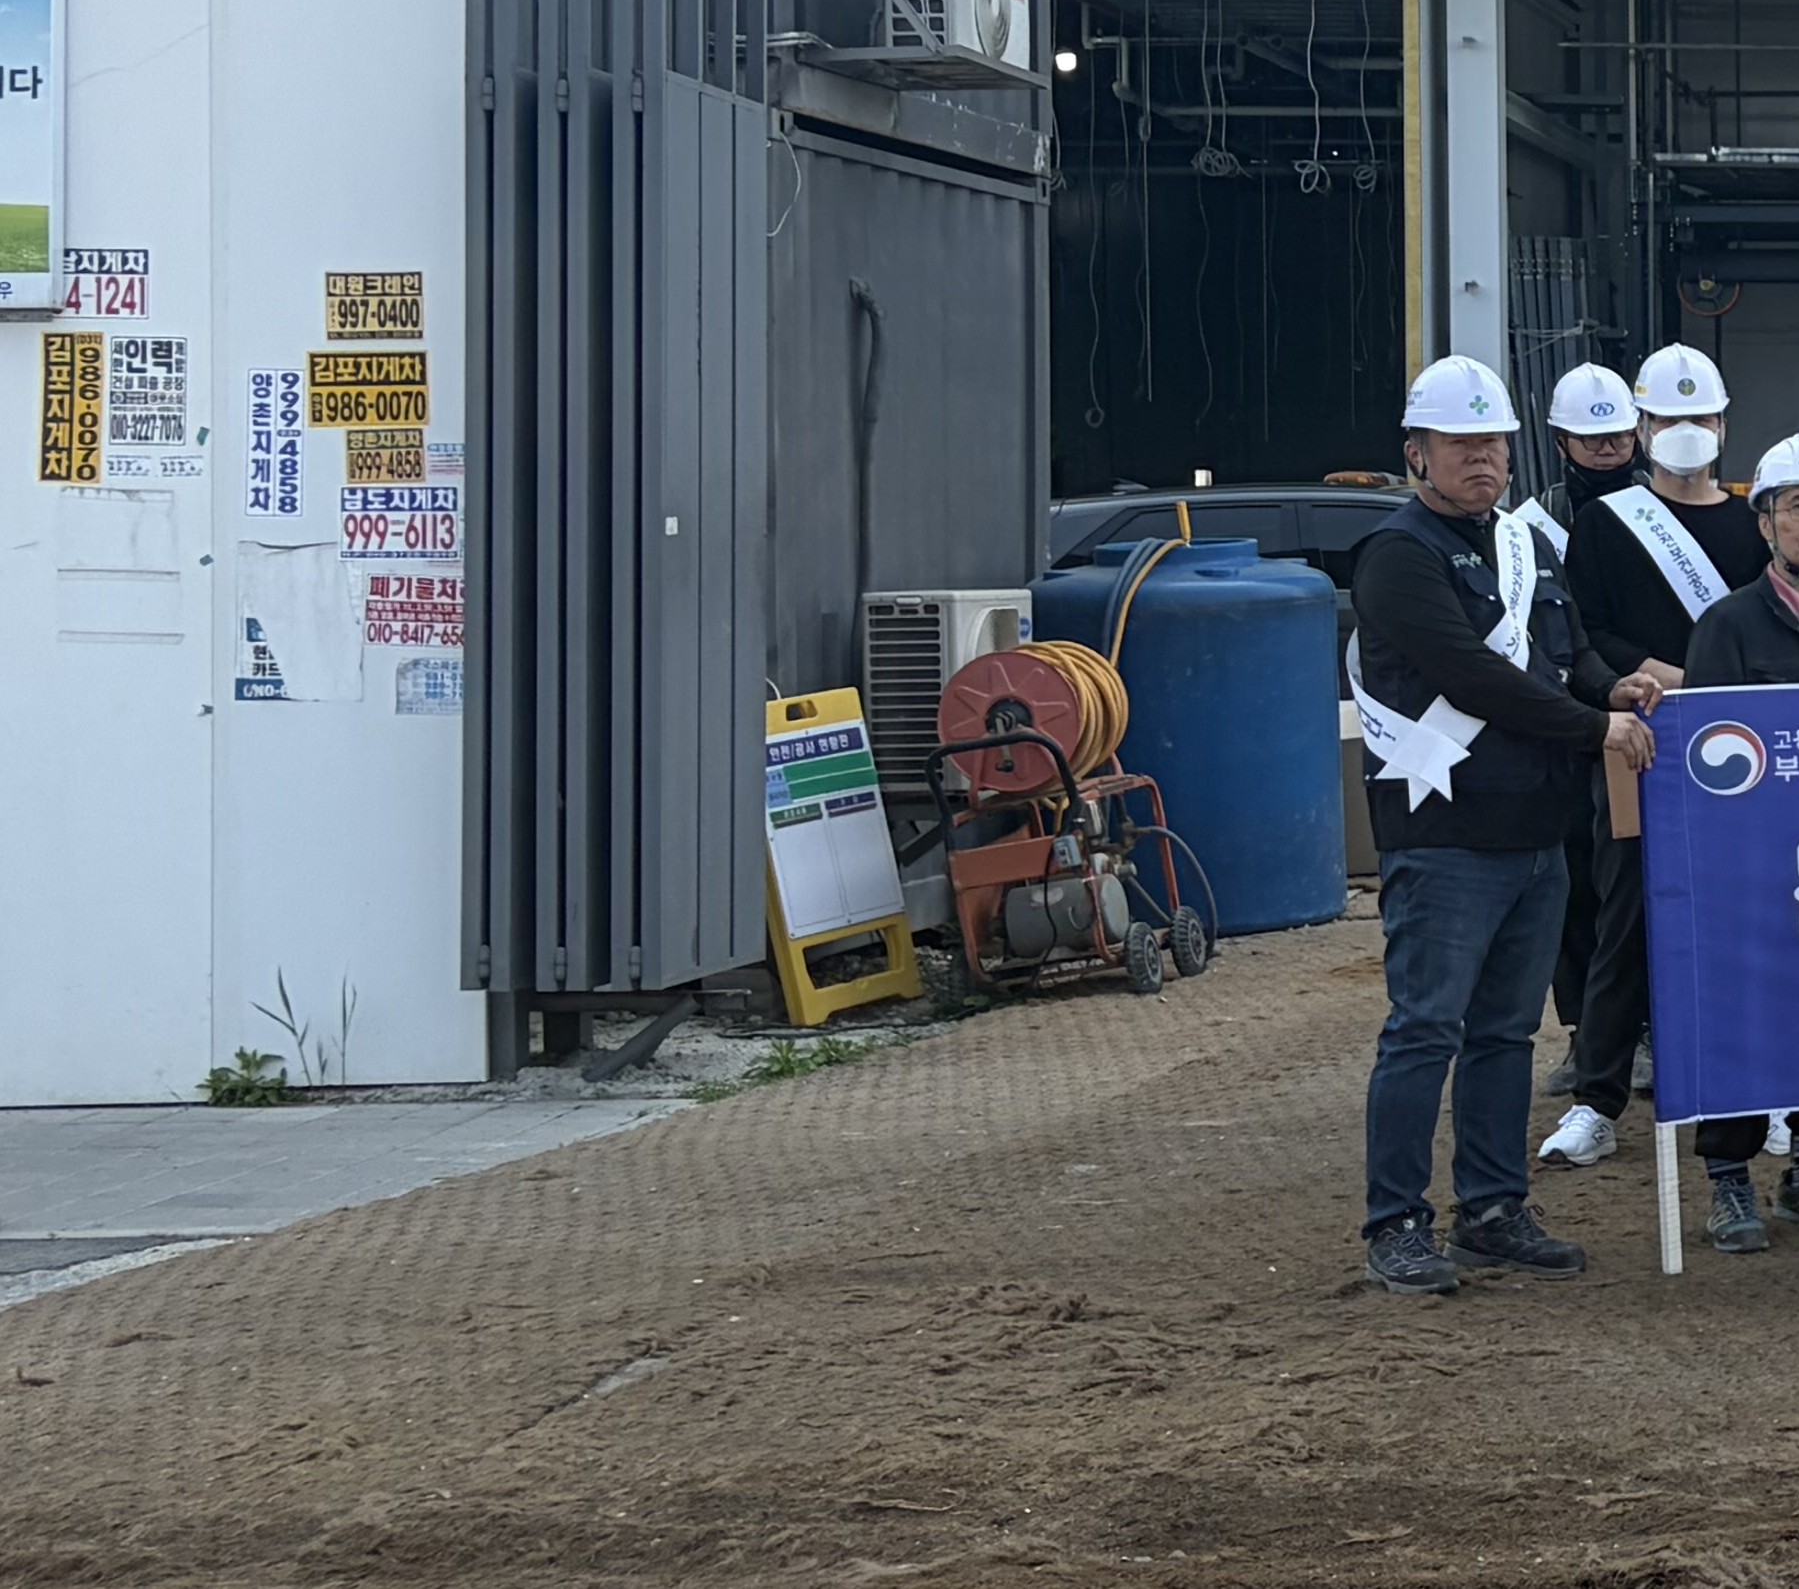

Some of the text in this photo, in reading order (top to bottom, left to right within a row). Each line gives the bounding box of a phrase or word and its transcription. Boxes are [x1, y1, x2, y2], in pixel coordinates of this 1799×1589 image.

[0, 65, 43, 101] 다
[62, 276, 146, 315] 4-1241
[124, 339, 173, 374] 인력
[313, 356, 423, 383] 김포지게차
[45, 336, 71, 478] 김포지게차
[249, 373, 273, 512] 양촌지게차
[343, 488, 456, 510] 남도지게차
[369, 576, 464, 601] 폐기물처
